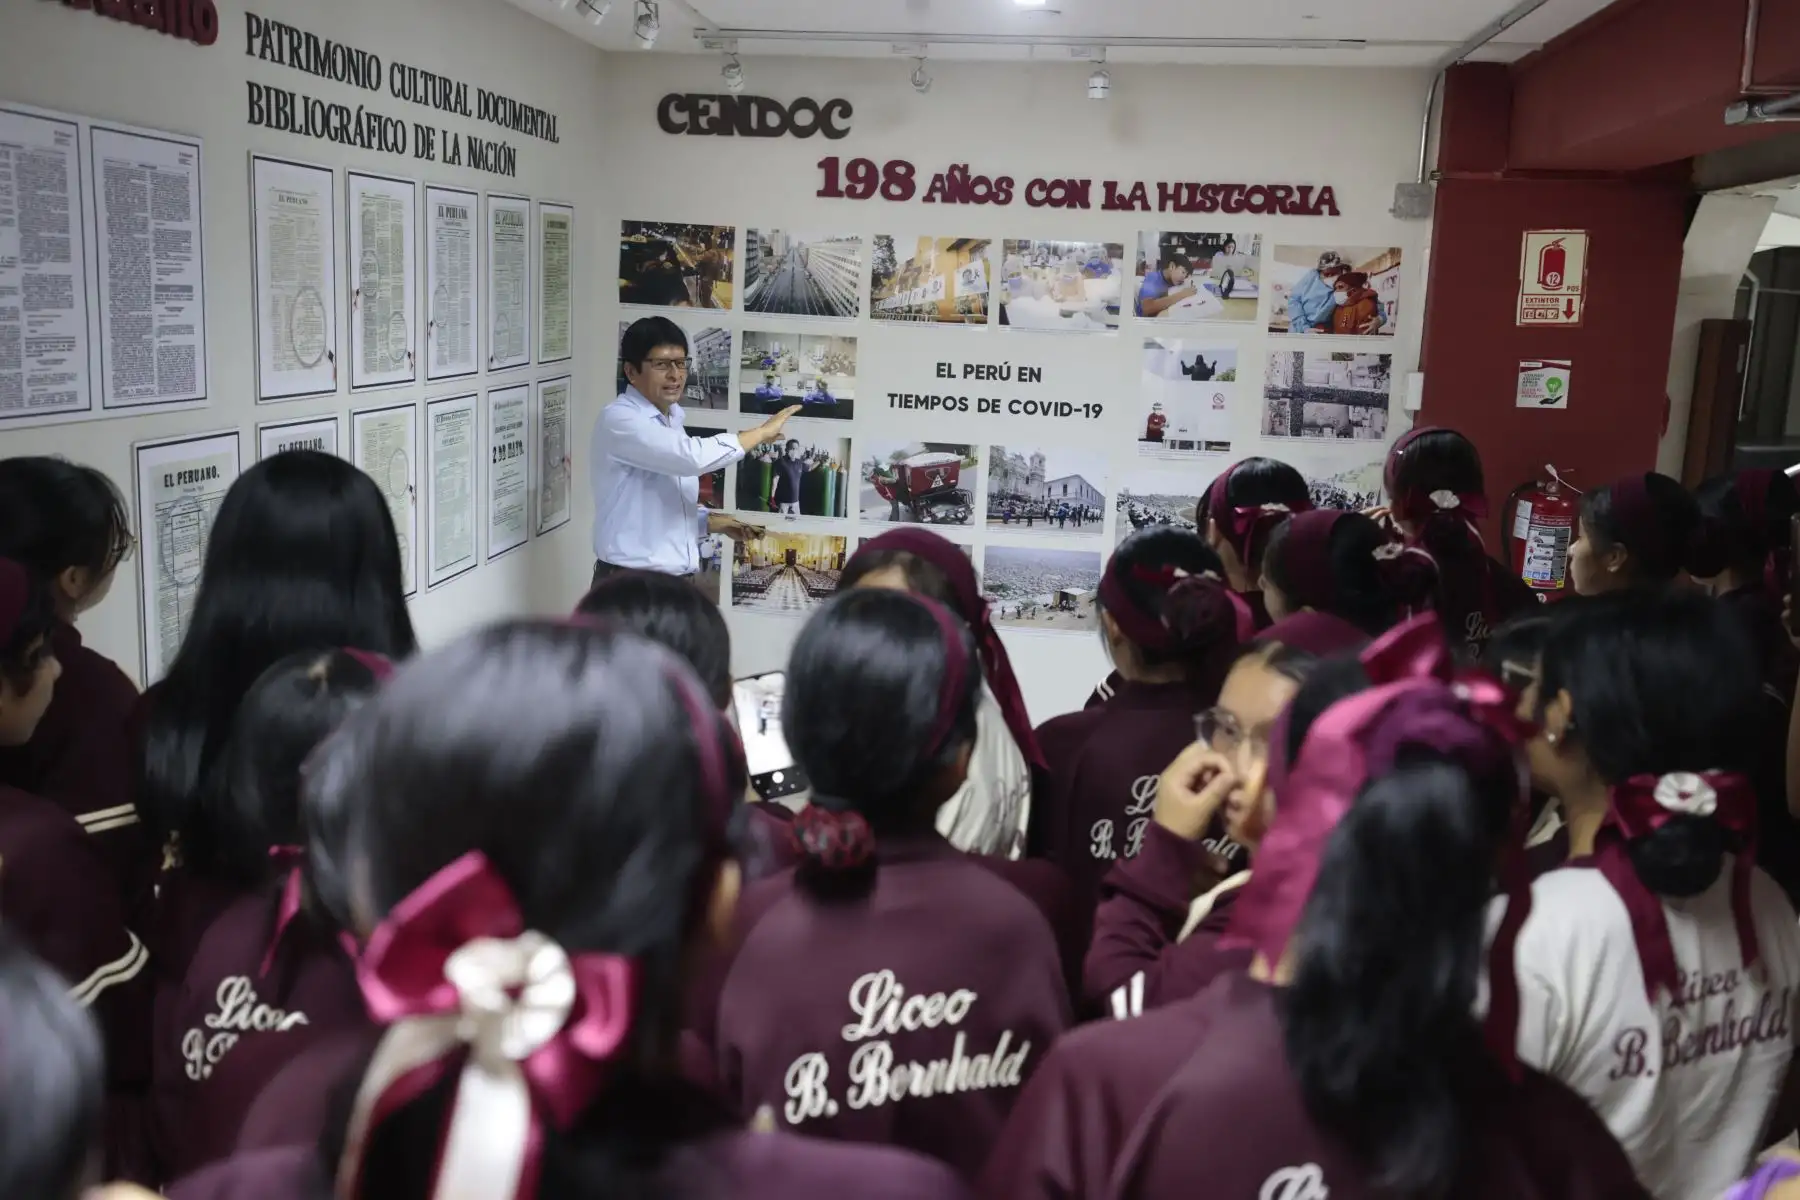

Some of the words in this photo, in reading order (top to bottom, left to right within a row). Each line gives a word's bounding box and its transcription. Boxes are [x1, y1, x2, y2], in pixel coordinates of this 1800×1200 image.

[245, 12, 382, 91] PATRIMONIO
[390, 61, 472, 117] CULTURAL
[477, 87, 560, 143] DOCUMENTAL
[246, 80, 407, 155] BIBLIOGRÁFICO
[413, 122, 435, 161] DE
[442, 129, 462, 166] LA
[467, 135, 517, 178] NACIÓN
[657, 93, 853, 140] CENDOC
[816, 156, 916, 202] 198
[1025, 178, 1092, 209] CON
[1100, 180, 1152, 212] LA
[1156, 181, 1341, 217] HISTORIA
[1549, 274, 1560, 285] 12
[936, 362, 957, 379] EL
[963, 361, 1012, 382] PERÚ
[1017, 366, 1042, 383] EN
[887, 393, 969, 412] TIEMPOS
[977, 398, 1001, 414] DE
[1008, 399, 1104, 419] COVID-19
[164, 474, 175, 488] EL
[177, 465, 220, 485] PERUANO.
[841, 969, 977, 1041] Liceo
[1608, 1027, 1655, 1081] B.
[784, 1052, 839, 1124] B.
